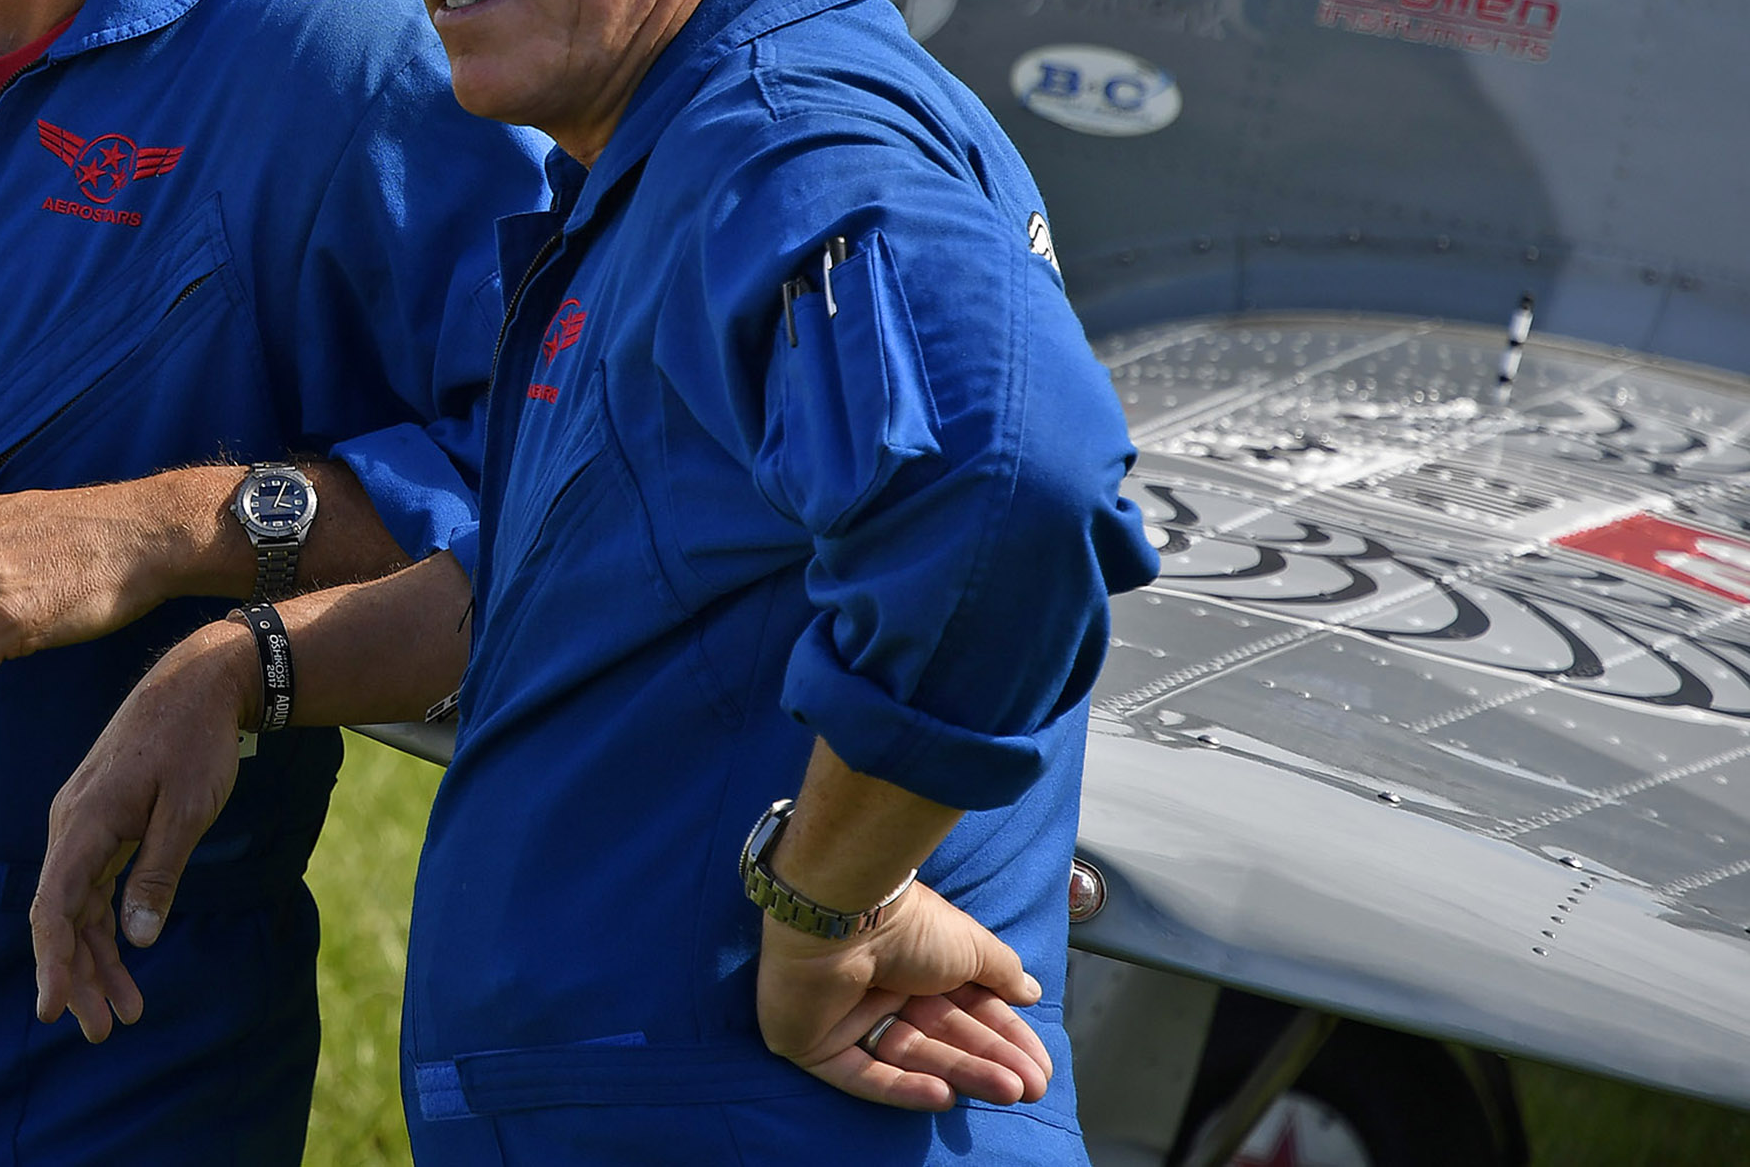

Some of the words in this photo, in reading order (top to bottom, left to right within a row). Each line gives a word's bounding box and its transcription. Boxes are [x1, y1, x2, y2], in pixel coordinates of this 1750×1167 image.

[41, 196, 142, 227] AEROSTARS
[266, 664, 277, 689] 2017
[270, 634, 285, 688] OSHKOSH
